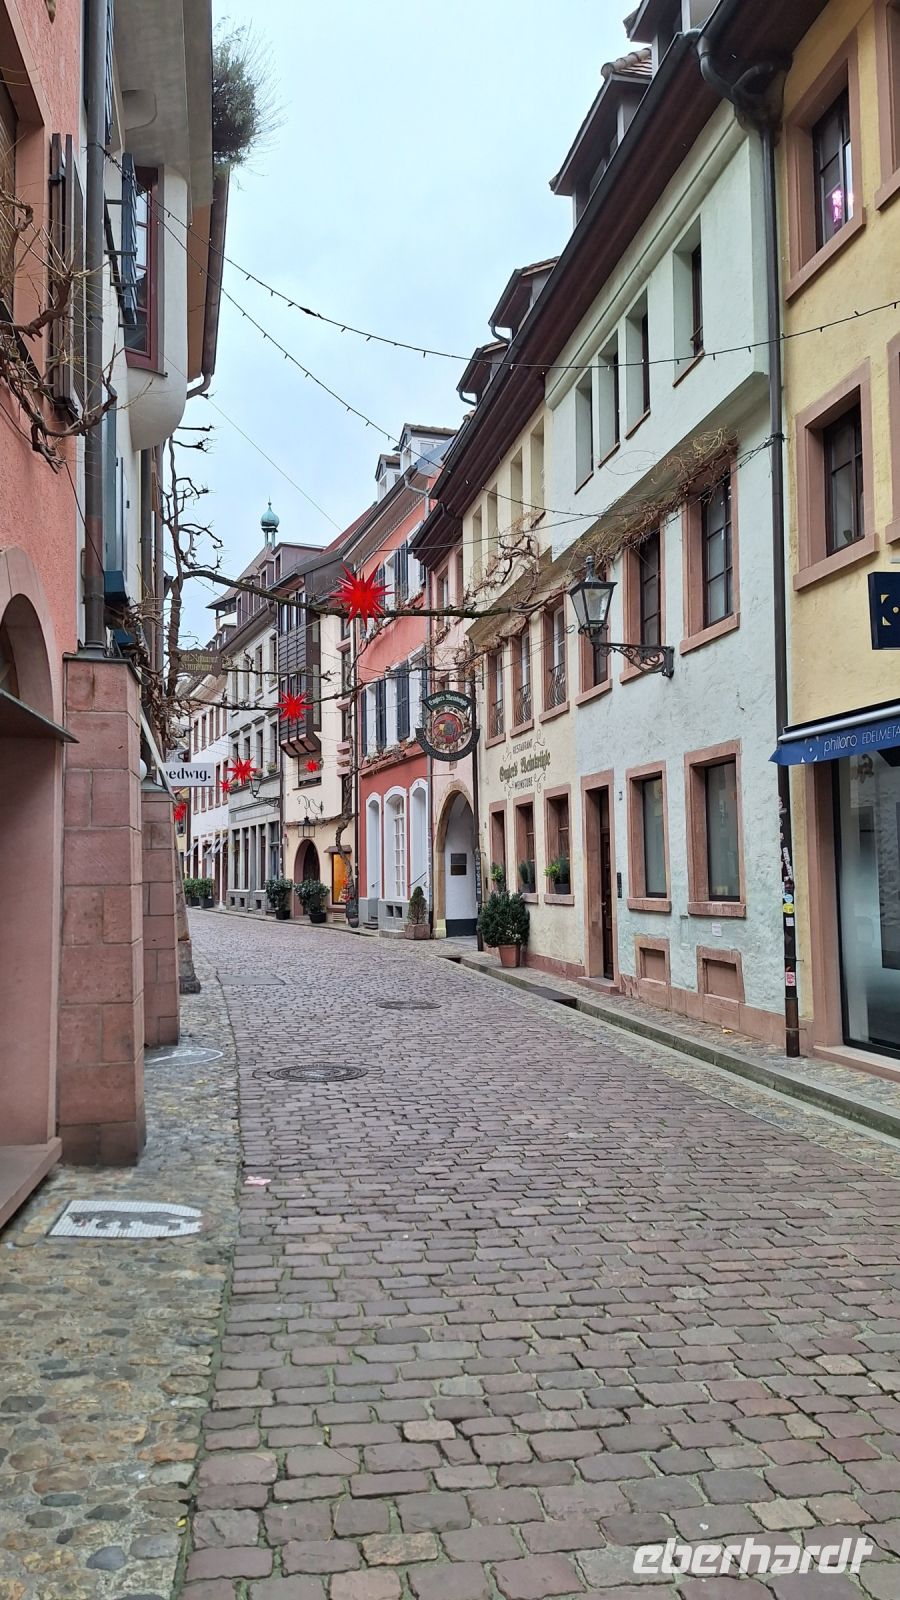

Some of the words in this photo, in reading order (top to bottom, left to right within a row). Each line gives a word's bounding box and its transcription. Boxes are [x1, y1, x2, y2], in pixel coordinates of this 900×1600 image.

[512, 739, 533, 755] RESTAURANT
[823, 735, 858, 756] philoro
[165, 767, 211, 782] edwig.
[514, 777, 533, 790] WEINSTUBE
